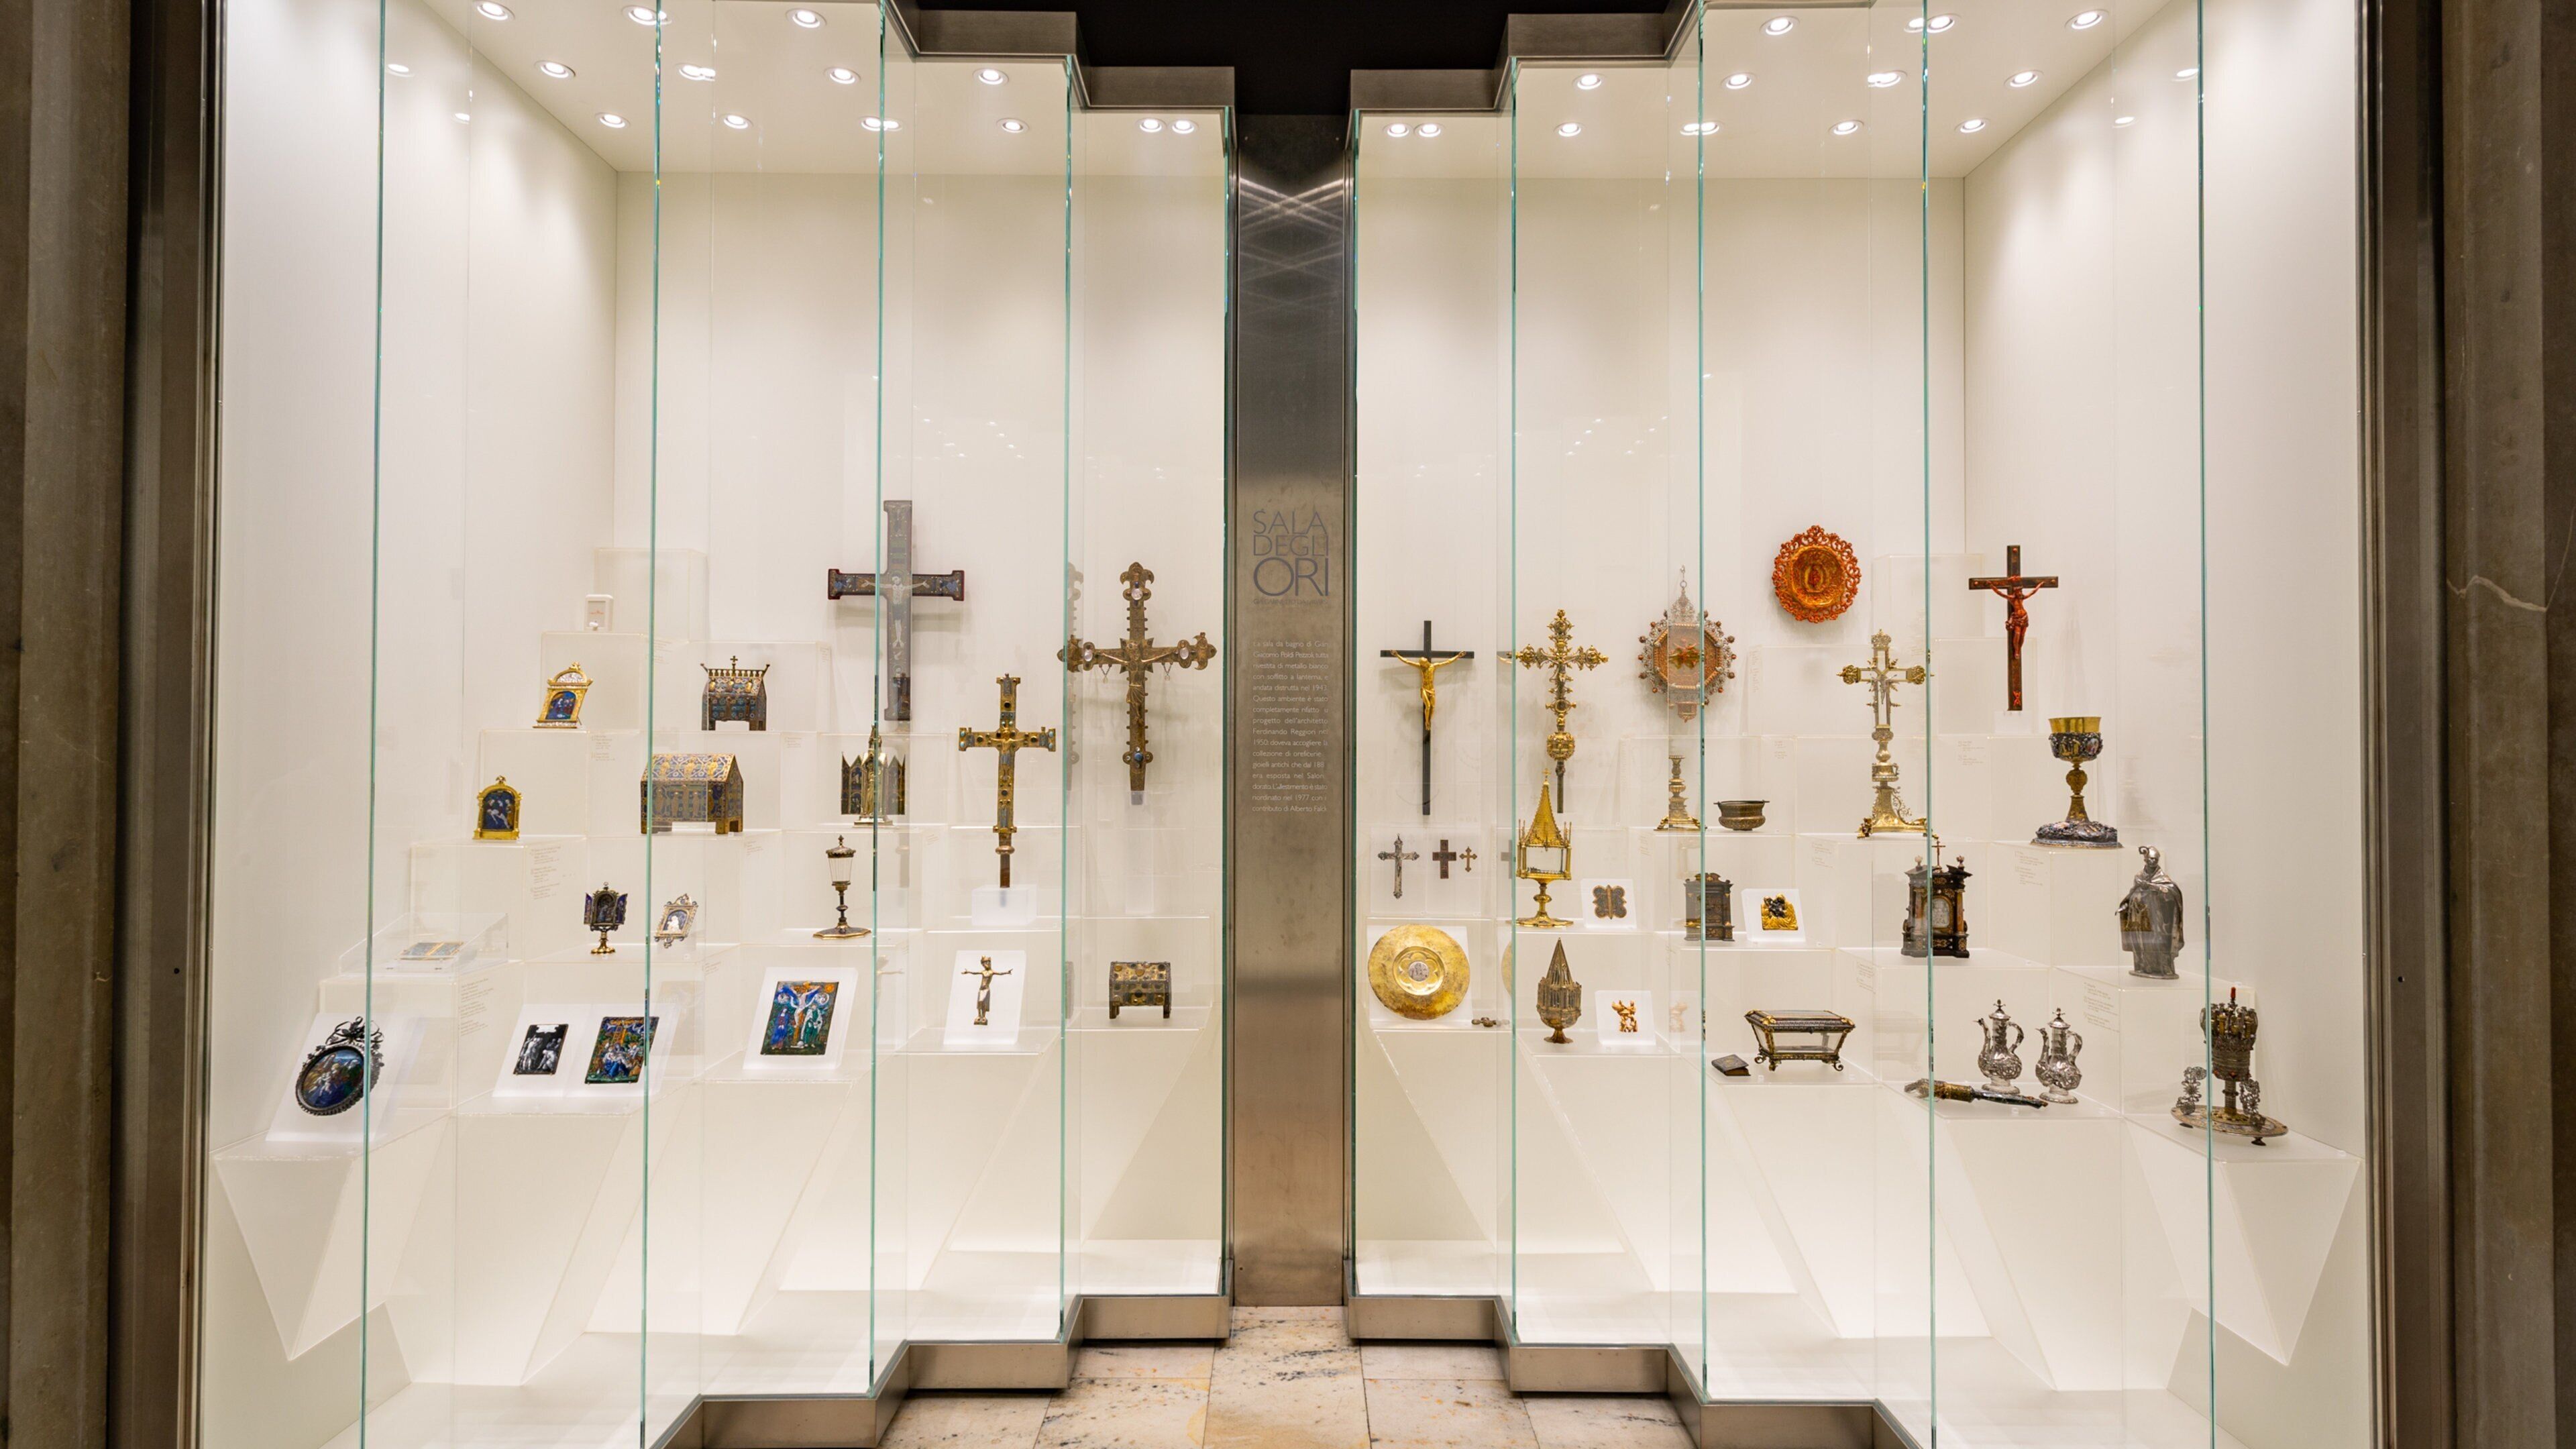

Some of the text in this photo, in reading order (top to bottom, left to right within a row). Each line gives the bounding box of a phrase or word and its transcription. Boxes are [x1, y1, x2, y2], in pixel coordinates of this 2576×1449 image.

[1253, 511, 1327, 534] SALA
[1253, 535, 1328, 556] DEGLI
[1253, 557, 1329, 596] ORI
